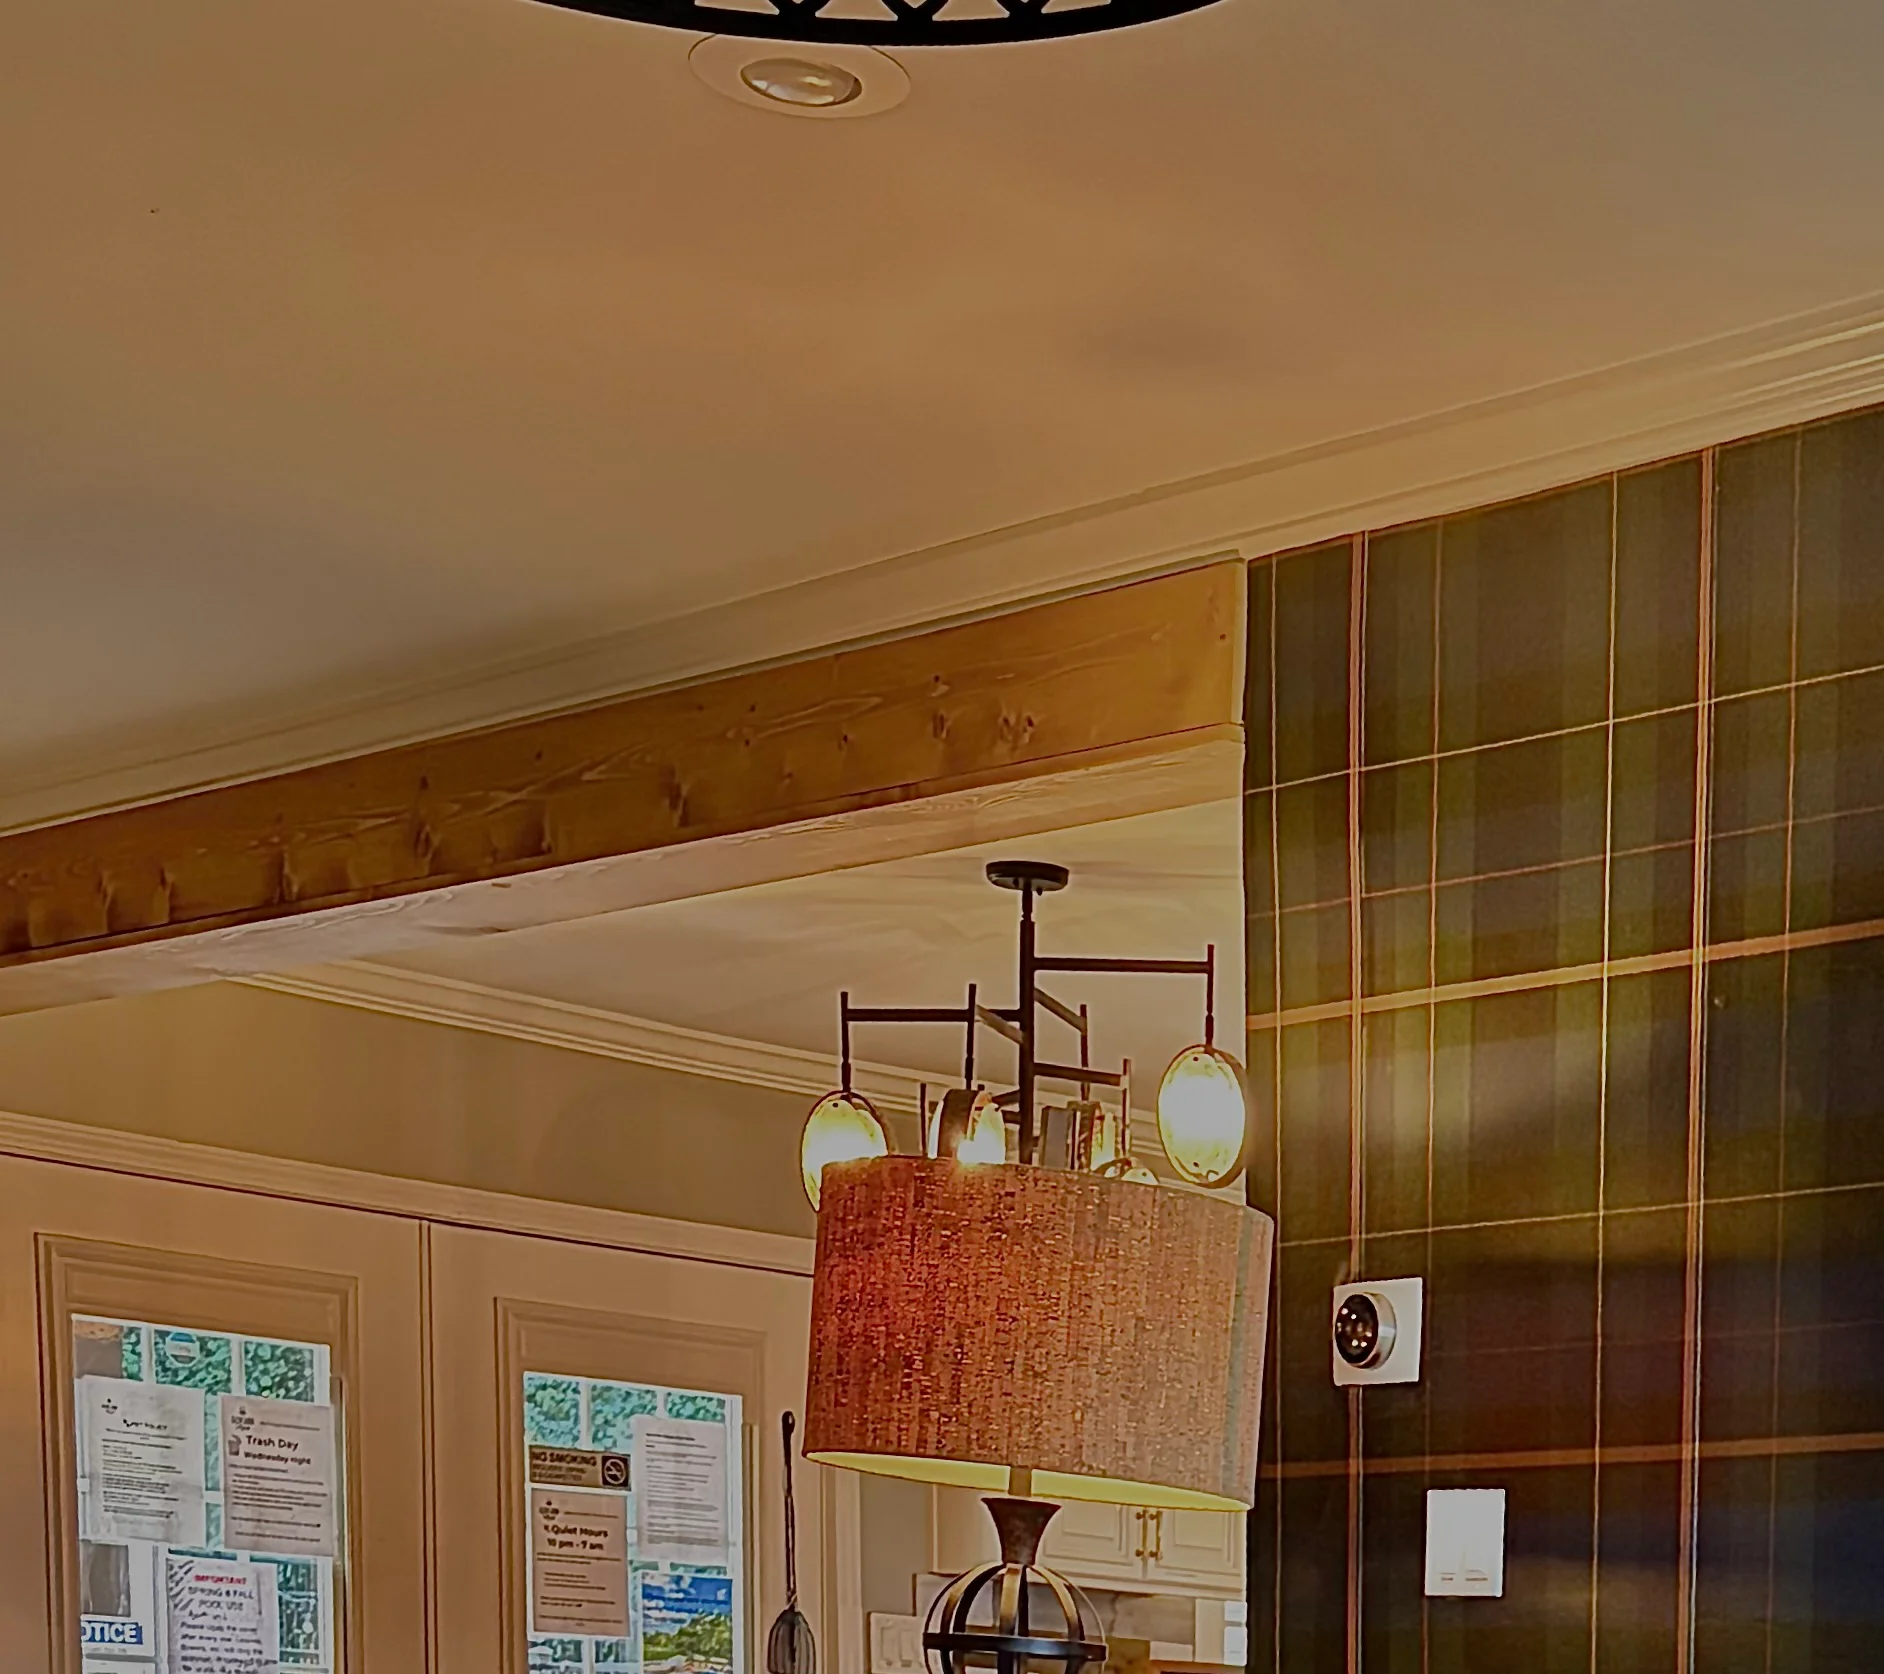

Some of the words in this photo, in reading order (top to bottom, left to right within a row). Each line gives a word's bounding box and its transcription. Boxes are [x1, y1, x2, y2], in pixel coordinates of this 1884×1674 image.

[246, 1435, 275, 1447] Trash
[278, 1439, 299, 1452] Day
[531, 1451, 547, 1461] NO
[549, 1452, 597, 1467] SMOKING
[551, 1524, 577, 1536] Quiet
[579, 1528, 608, 1538] Hours
[558, 1540, 574, 1550] pm
[194, 1574, 247, 1585] IMPORTANT
[81, 1621, 138, 1643] OTICE
